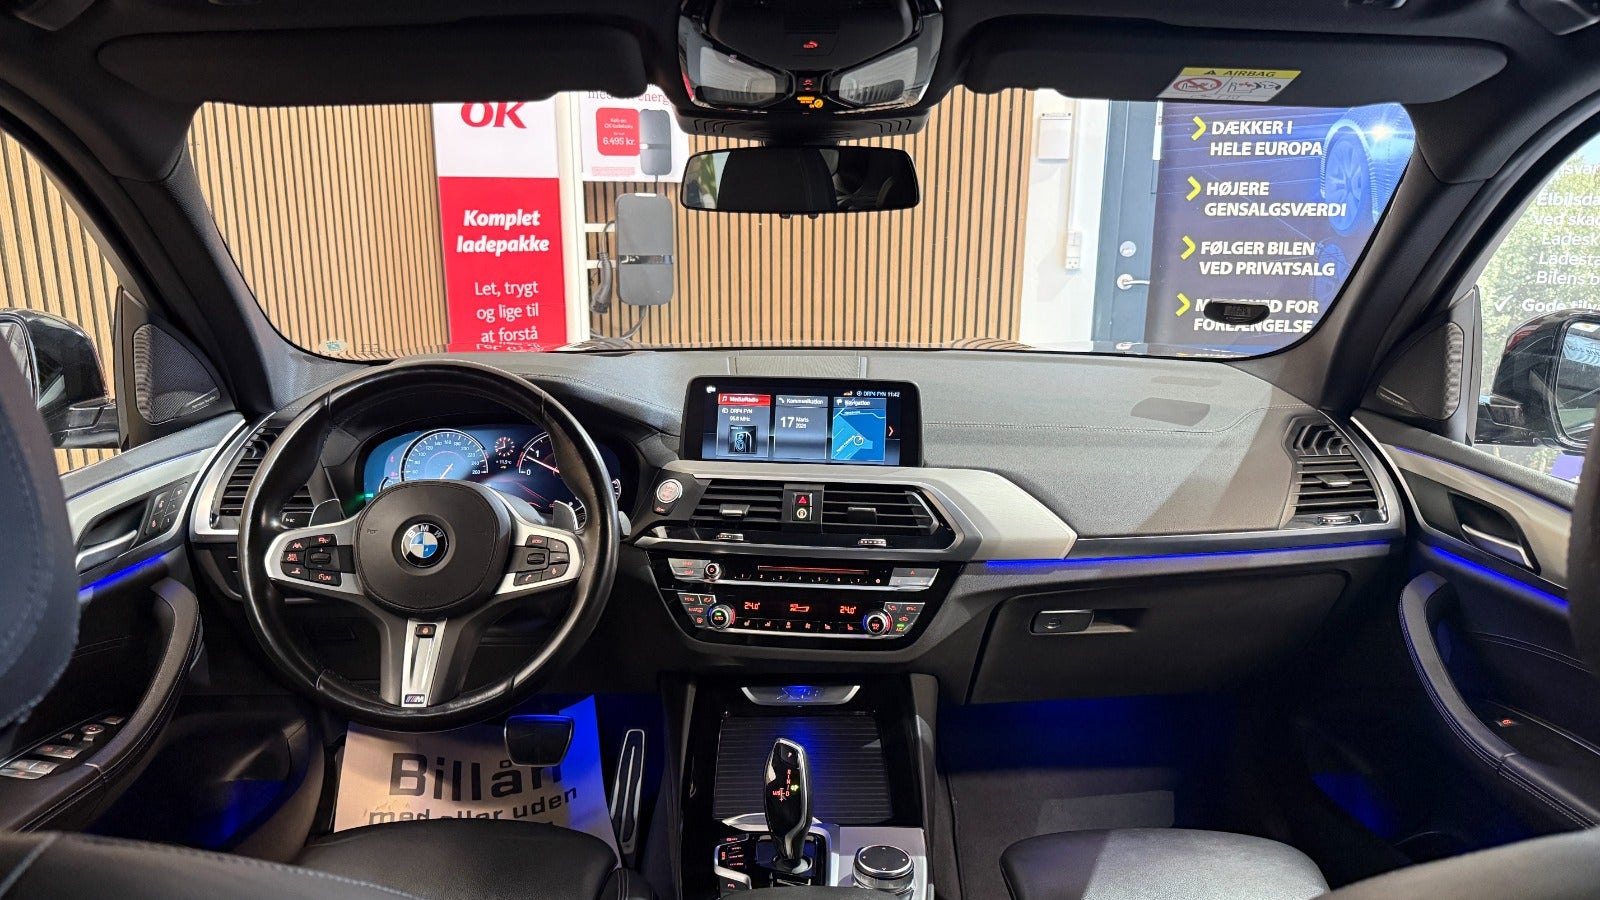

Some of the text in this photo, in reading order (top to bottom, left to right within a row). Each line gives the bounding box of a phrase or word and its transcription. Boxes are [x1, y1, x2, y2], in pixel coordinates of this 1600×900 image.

[461, 102, 527, 129] OK
[1211, 121, 1293, 135] DÆKKER I
[602, 137, 636, 146] 6.495 kr.
[1210, 142, 1323, 156] HELE EUROPA
[1206, 182, 1270, 196] HØJERE
[1204, 203, 1347, 217] GENSALGSVÆRDI
[463, 209, 541, 229] Komplet
[1534, 213, 1564, 226] ved
[456, 235, 550, 257] ladepakke
[1201, 242, 1316, 256] FØLGER BILEN
[1199, 262, 1335, 277] VED PRIVATSALG
[1536, 271, 1585, 285] Bilens
[474, 280, 538, 298] Let, trygt
[1285, 301, 1318, 314] FOR
[1522, 299, 1567, 313] Gode
[477, 304, 539, 323] og lige til
[1193, 319, 1313, 334] FORLÆNGELSE
[481, 326, 539, 343] at forstå
[780, 416, 795, 428] 17
[535, 450, 540, 458] 1
[407, 524, 444, 539] BMW
[512, 786, 577, 819] uden
